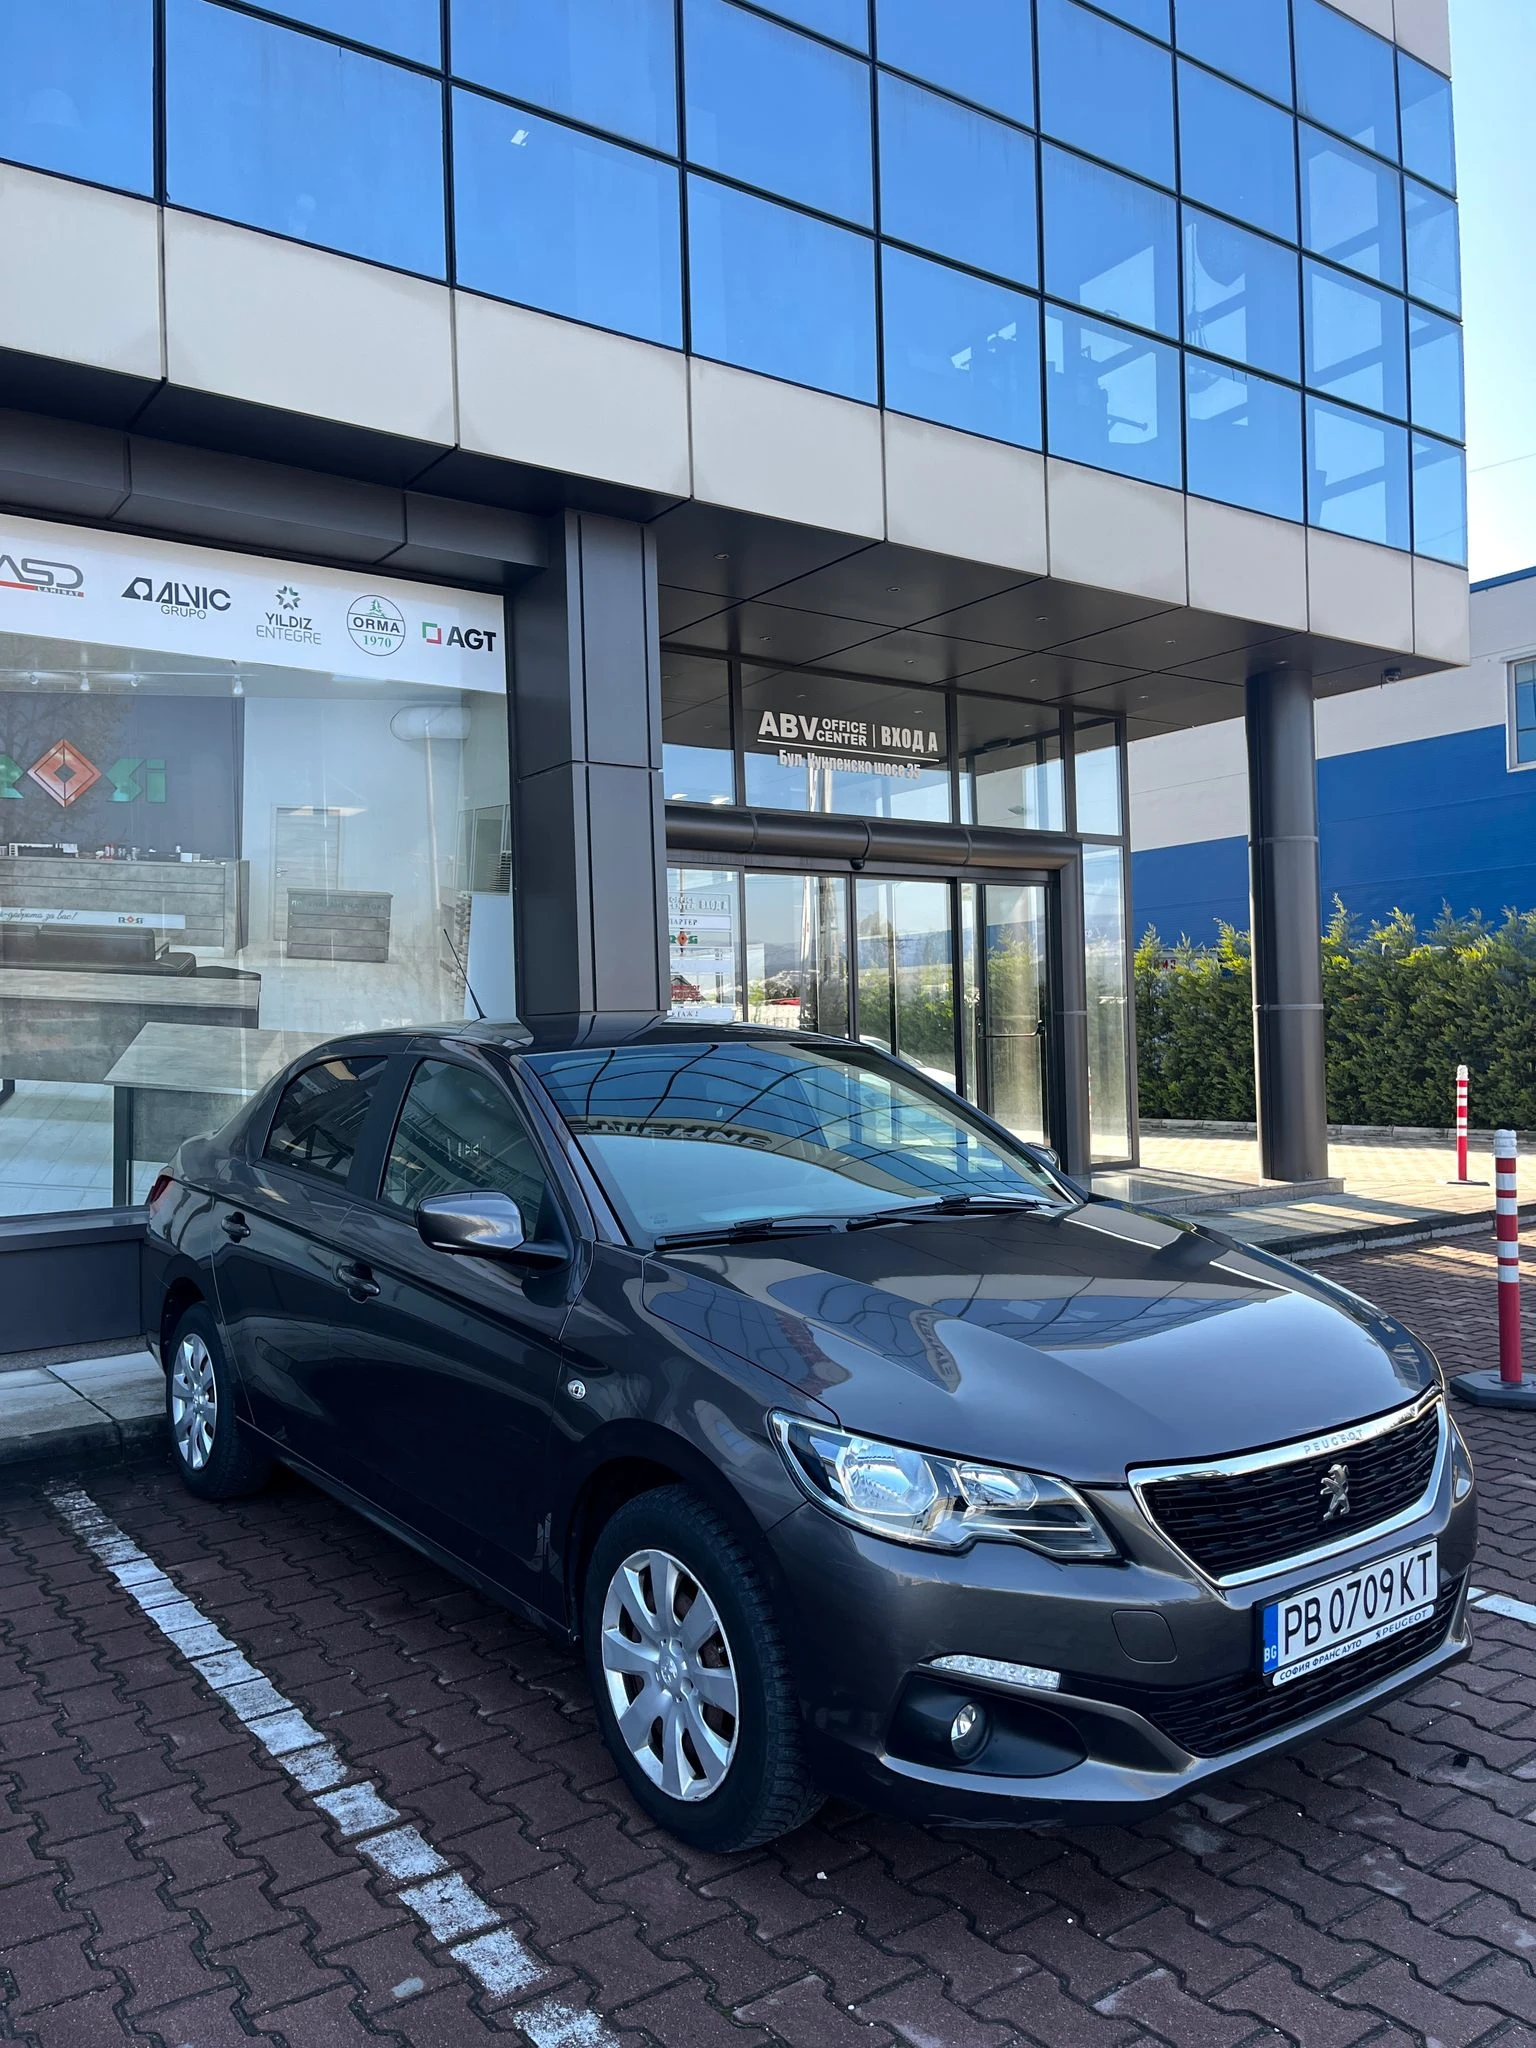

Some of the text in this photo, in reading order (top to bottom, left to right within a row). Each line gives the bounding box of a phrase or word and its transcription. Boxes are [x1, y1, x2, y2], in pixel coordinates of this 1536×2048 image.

[155, 581, 231, 612] ALVIC
[161, 604, 207, 620] GRUPO
[265, 612, 312, 630] YILDIZ
[256, 625, 322, 645] ENTEGRE
[353, 616, 401, 634] ORMA
[363, 635, 392, 648] 1970
[446, 626, 496, 652] AGT
[758, 711, 819, 741] ABV
[821, 718, 867, 734] OFFICE
[816, 730, 867, 747] CENTER
[881, 726, 924, 753] ВХОД
[874, 762, 905, 777] шосе
[906, 763, 921, 779] 35
[1303, 1429, 1363, 1454] PEUGEOT
[1284, 1550, 1433, 1656] PB 0709 KT
[1382, 1609, 1428, 1636] PEUGEOT
[1264, 1644, 1278, 1663] BG
[1279, 1639, 1362, 1681] СОФИЯ ФРАНС АУТО
